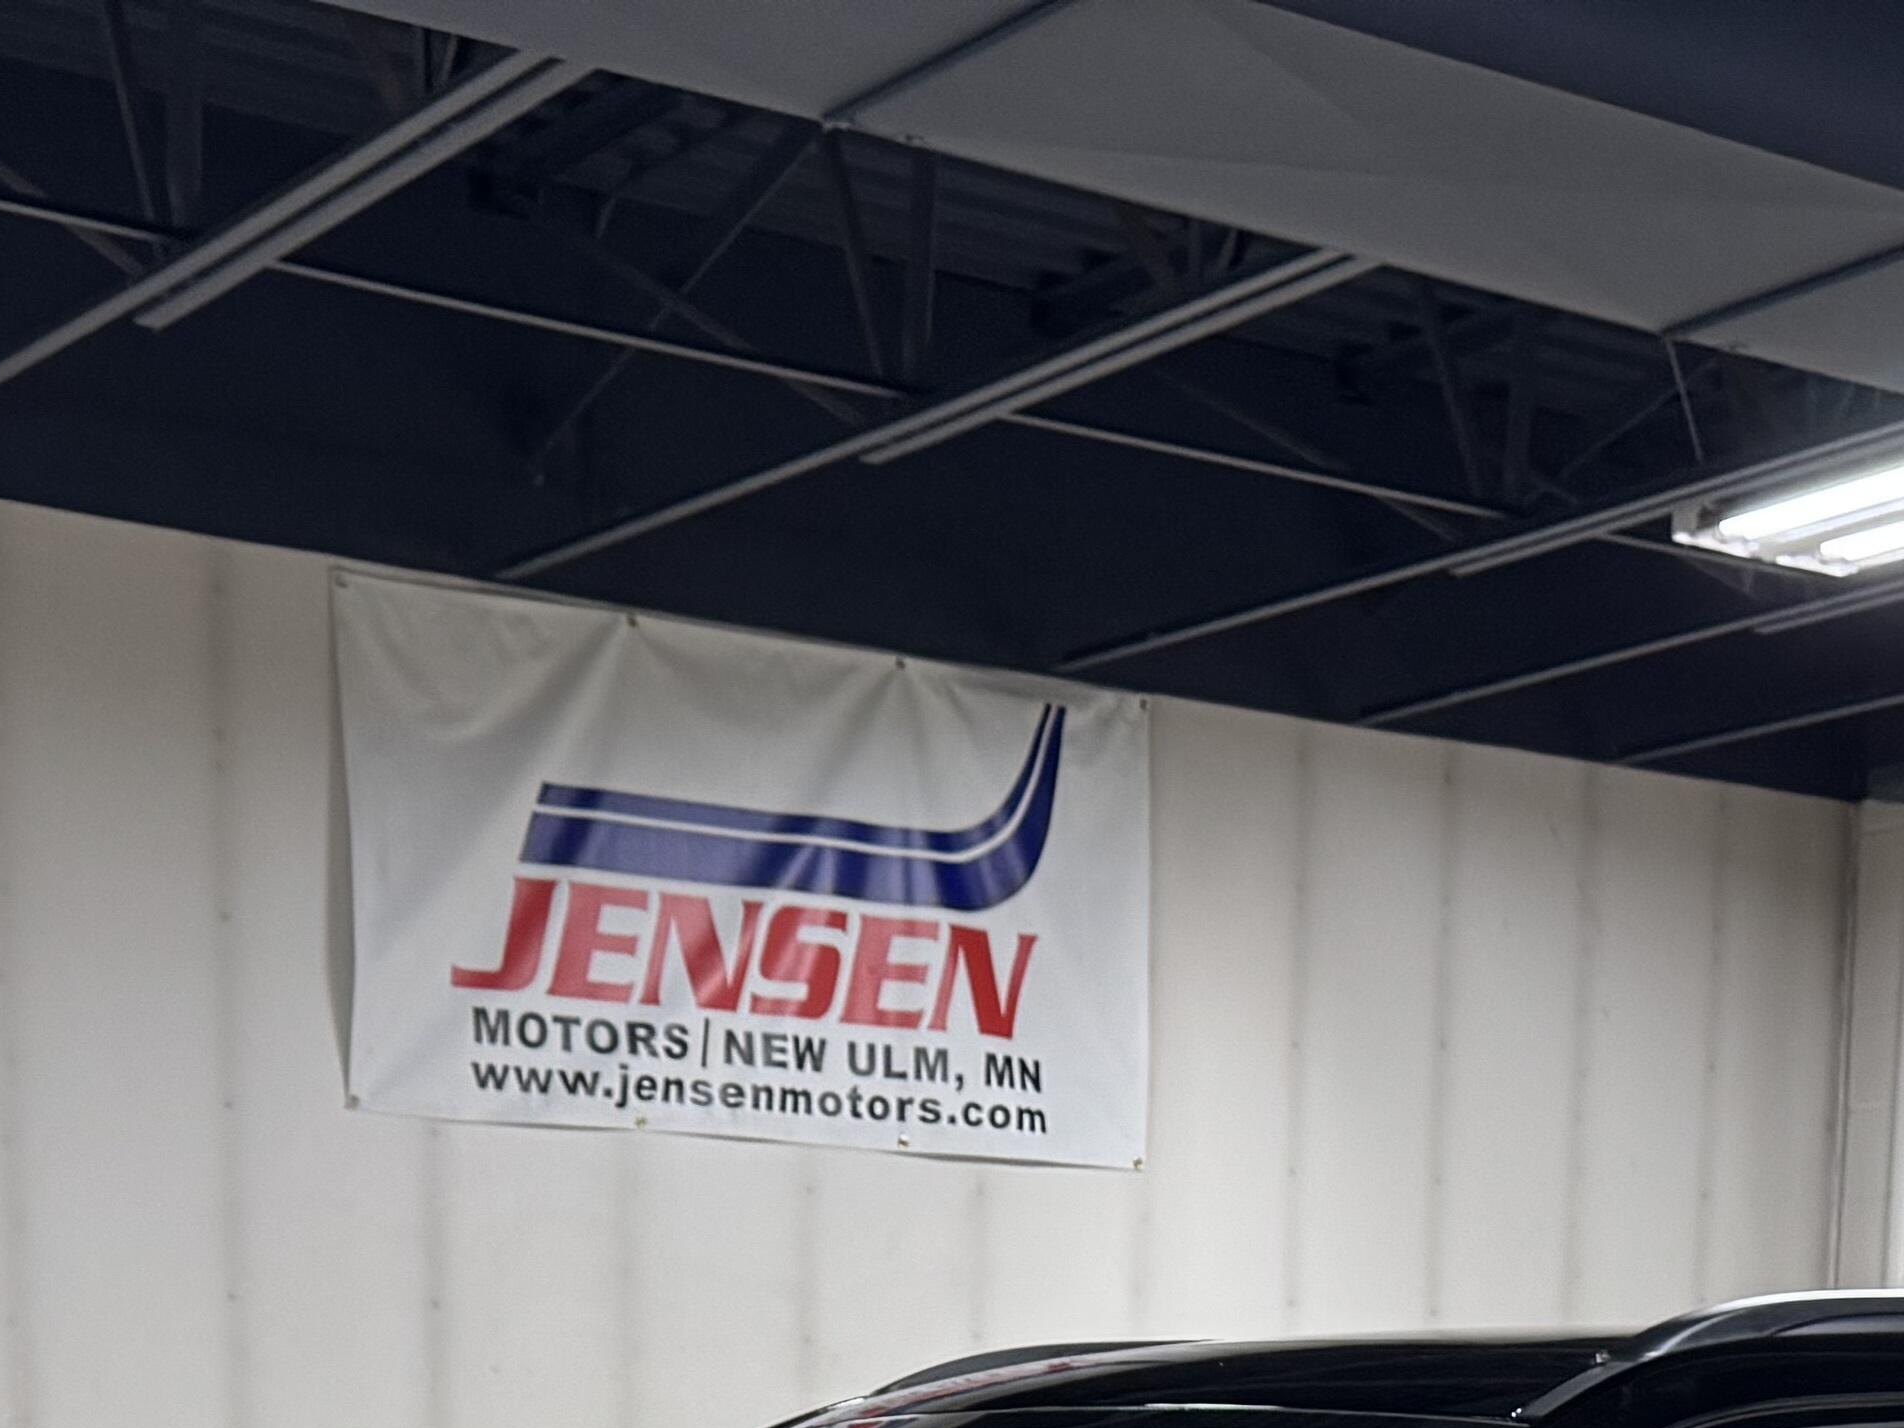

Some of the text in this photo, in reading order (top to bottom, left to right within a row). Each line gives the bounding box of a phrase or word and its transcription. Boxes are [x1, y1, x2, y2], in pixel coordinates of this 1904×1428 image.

[451, 876, 1038, 1040] JENSEN
[472, 1006, 1042, 1093] MOTORS NEW ULM, MN
[471, 1062, 1048, 1134] www.jensenmotors.com
